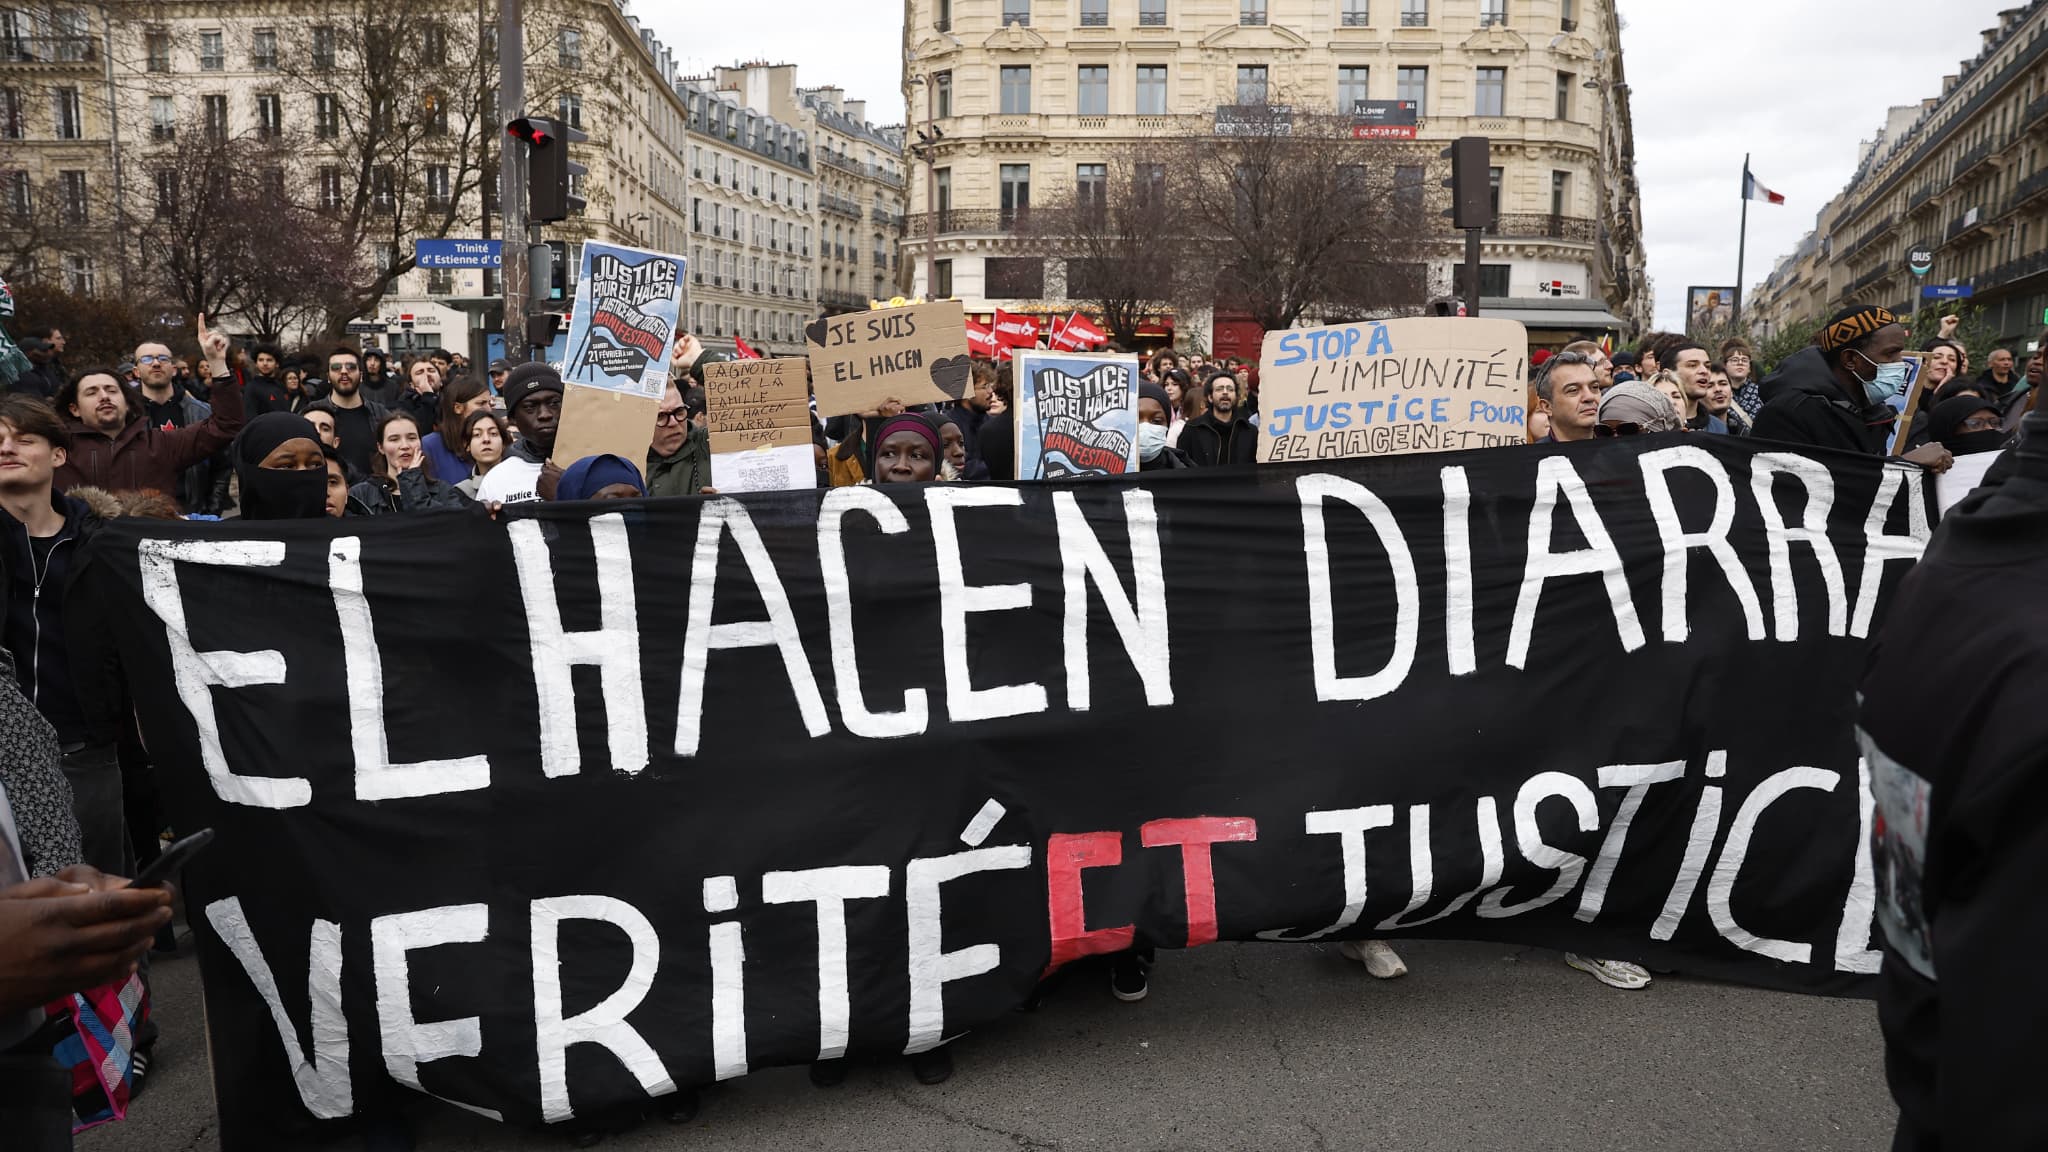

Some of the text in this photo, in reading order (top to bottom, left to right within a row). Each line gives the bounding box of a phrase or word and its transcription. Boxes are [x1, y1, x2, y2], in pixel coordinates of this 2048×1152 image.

[422, 254, 432, 264] d'
[435, 254, 478, 264] Estienne
[481, 254, 490, 264] d'
[455, 243, 489, 254] Trinité
[1911, 252, 1931, 262] BUS
[594, 256, 677, 285] JUSTICE
[593, 280, 674, 306] POUR EL HACEN
[1539, 282, 1550, 293] SG
[385, 316, 399, 326] SG
[599, 298, 668, 342] JUSTICE POUR TOUSTES
[829, 312, 916, 346] JE SUIS
[592, 311, 664, 360] MANIFESTATION
[1274, 322, 1393, 366] STOP À
[588, 350, 599, 363] 21
[598, 349, 622, 360] FÉVRIER
[834, 349, 923, 382] EL HACEN
[705, 361, 784, 379] CAGNOTTE
[1038, 366, 1129, 400] JUSTICE
[708, 377, 784, 396] POUR LA
[709, 391, 768, 410] FAMILLE
[710, 403, 788, 423] D'EL HACEN
[1039, 389, 1127, 421] POUR EL HACEN
[1470, 400, 1524, 427] POUR
[720, 418, 775, 432] DIARRA
[739, 431, 783, 442] MERCI
[1049, 417, 1129, 459] JUSTICE POUR TOUSTES
[1044, 433, 1126, 475] MANIFESTATION
[1268, 434, 1310, 462] EL
[1317, 423, 1439, 458] HACEN
[1442, 430, 1476, 449] ET
[505, 490, 532, 503] Justice
[138, 445, 1932, 808] EL HACEN DIARRA
[1038, 815, 1257, 979] ET
